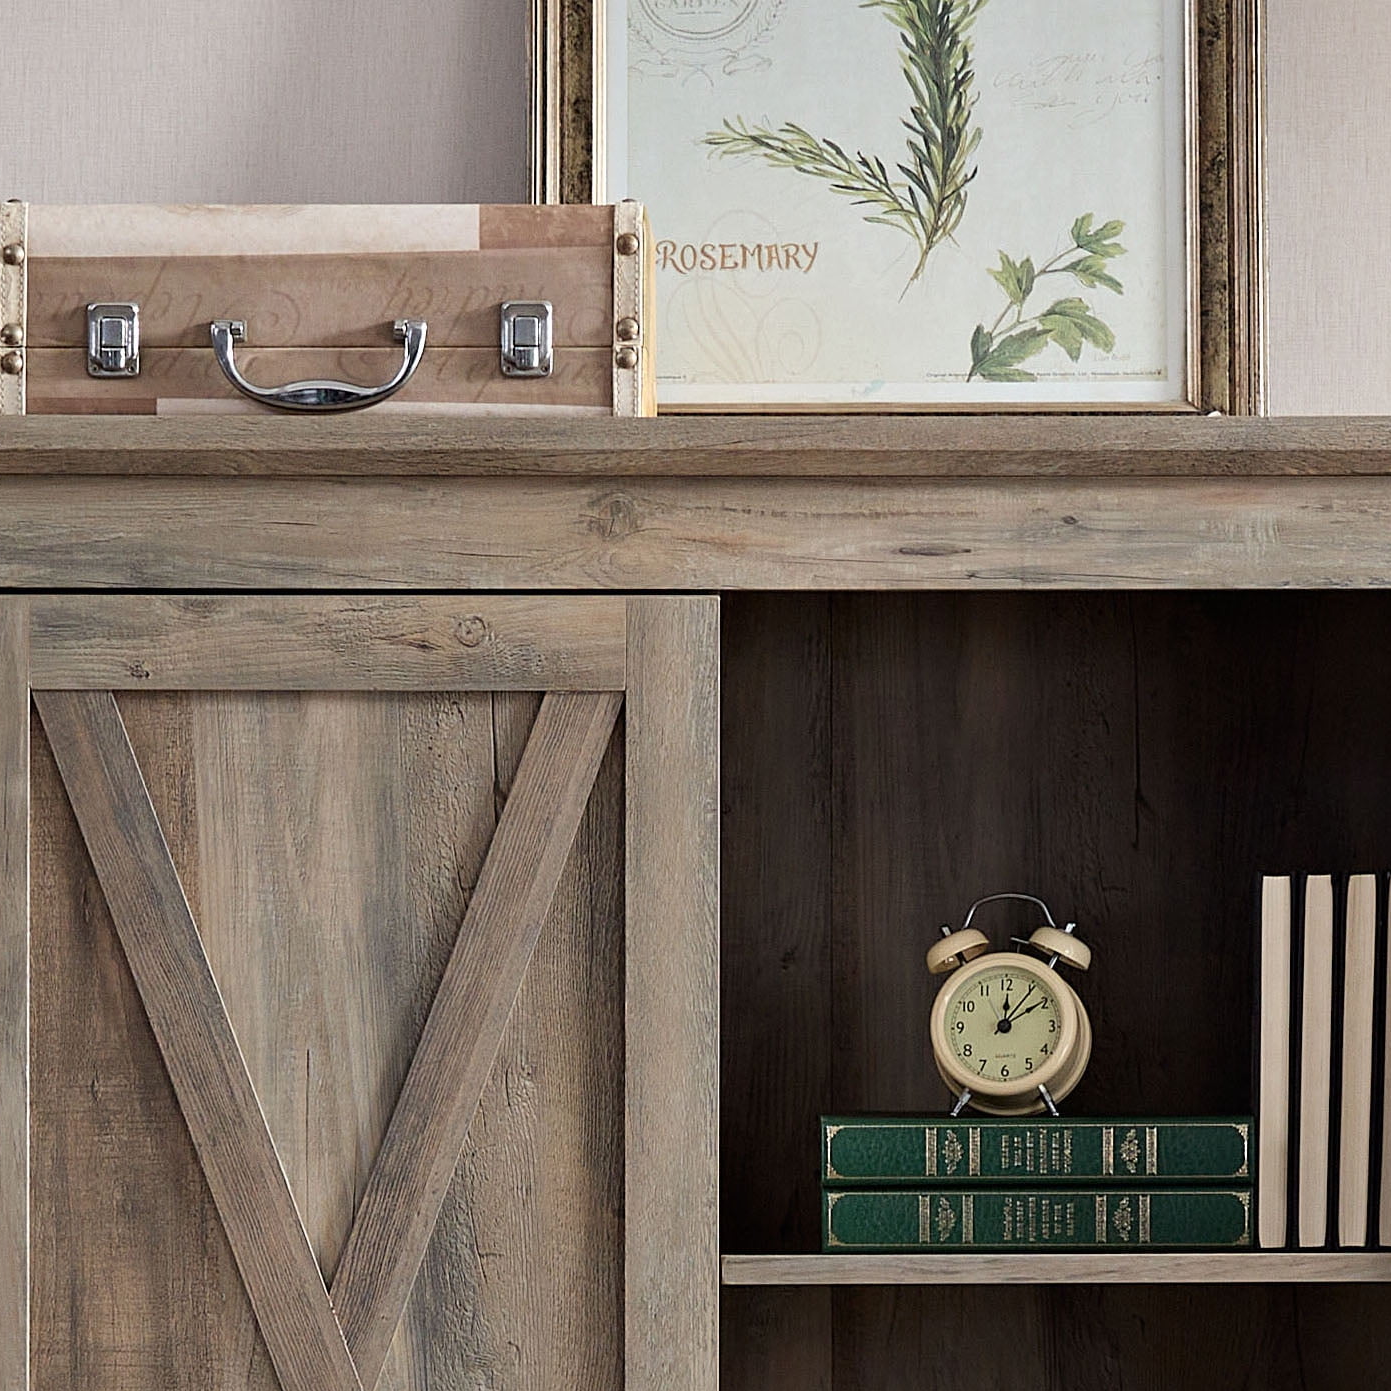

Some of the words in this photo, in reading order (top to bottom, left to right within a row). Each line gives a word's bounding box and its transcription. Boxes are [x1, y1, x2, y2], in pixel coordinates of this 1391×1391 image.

[656, 240, 819, 275] ROSEMARY
[980, 984, 989, 997] 11
[1001, 978, 1013, 991] 12
[962, 1000, 975, 1013] 10
[1041, 996, 1049, 1010] 2
[956, 1021, 965, 1034] 9
[1049, 1019, 1056, 1033] 3
[963, 1043, 973, 1057] 8
[1040, 1043, 1049, 1056] 4
[979, 1059, 988, 1072] 7
[1000, 1064, 1010, 1077] 6
[1025, 1057, 1033, 1071] 5
